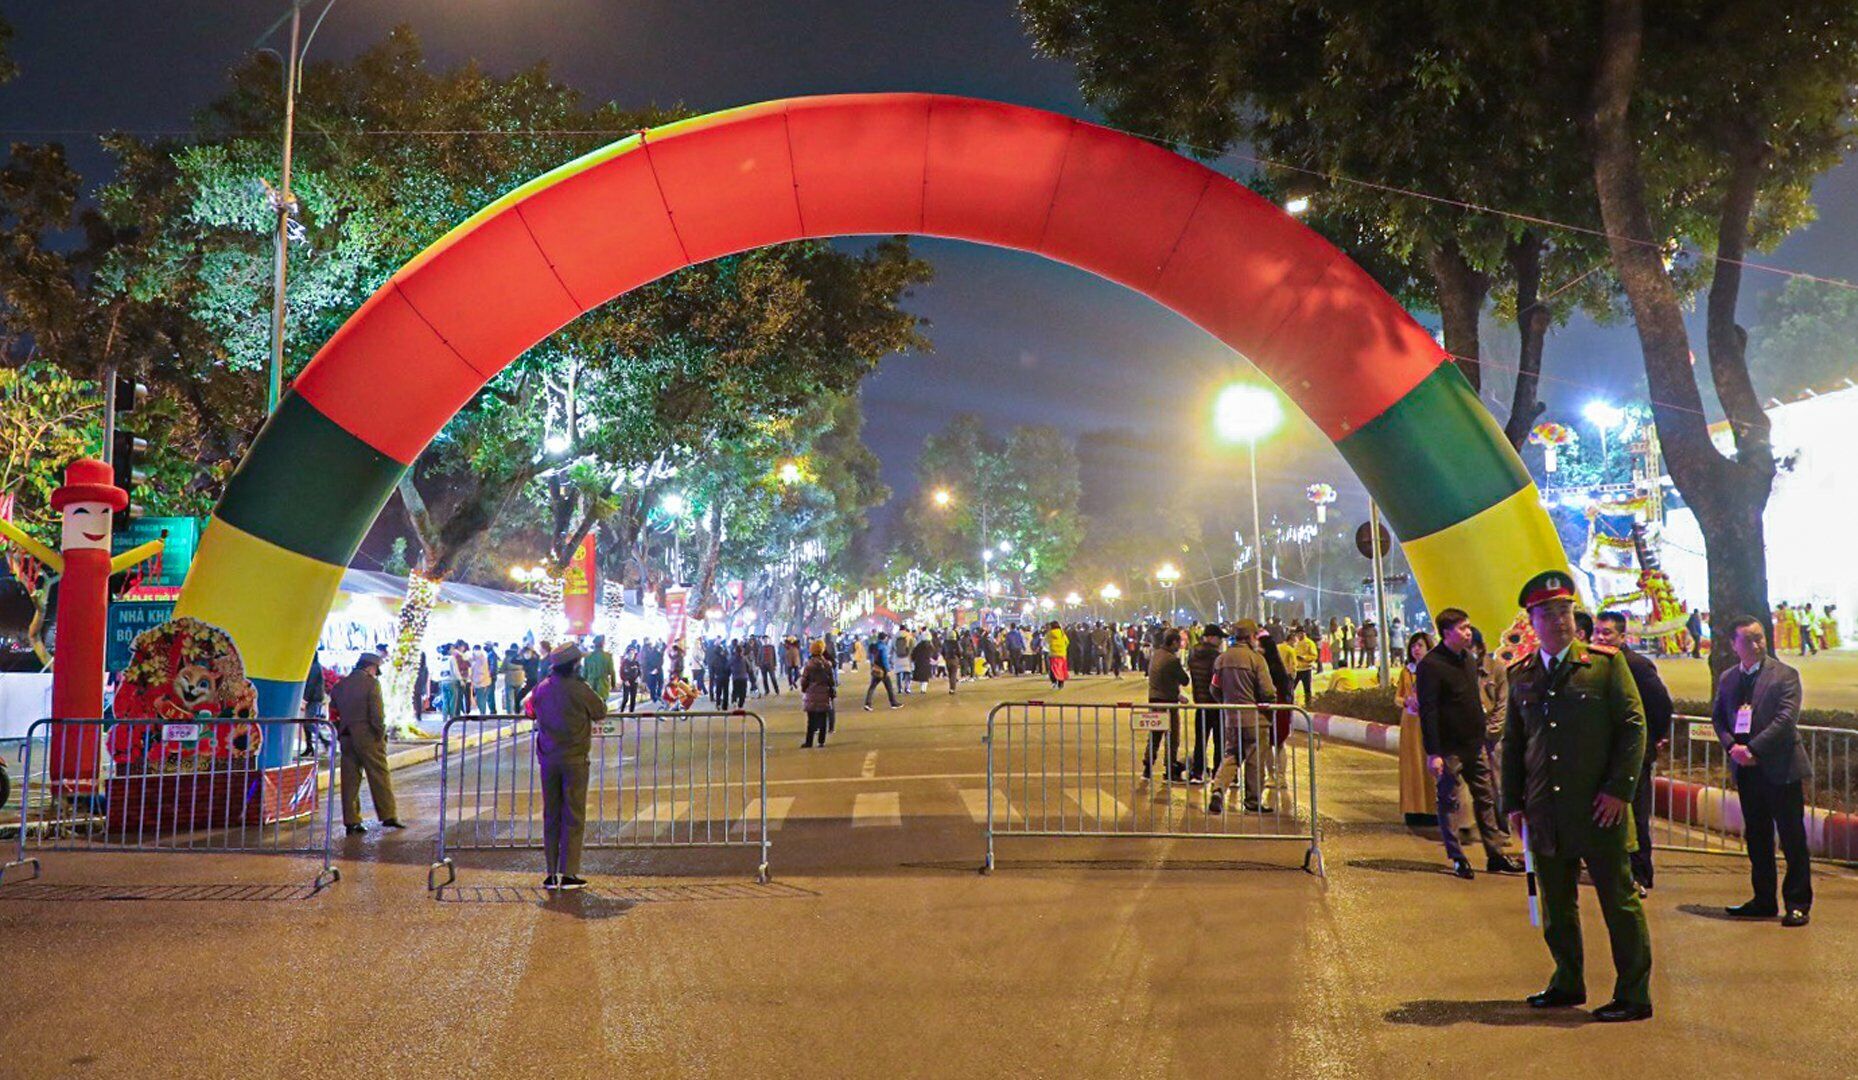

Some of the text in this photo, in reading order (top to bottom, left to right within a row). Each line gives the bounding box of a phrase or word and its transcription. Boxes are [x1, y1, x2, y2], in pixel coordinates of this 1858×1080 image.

[119, 607, 172, 623] NHÀ KHÁ
[168, 730, 191, 739] STOP
